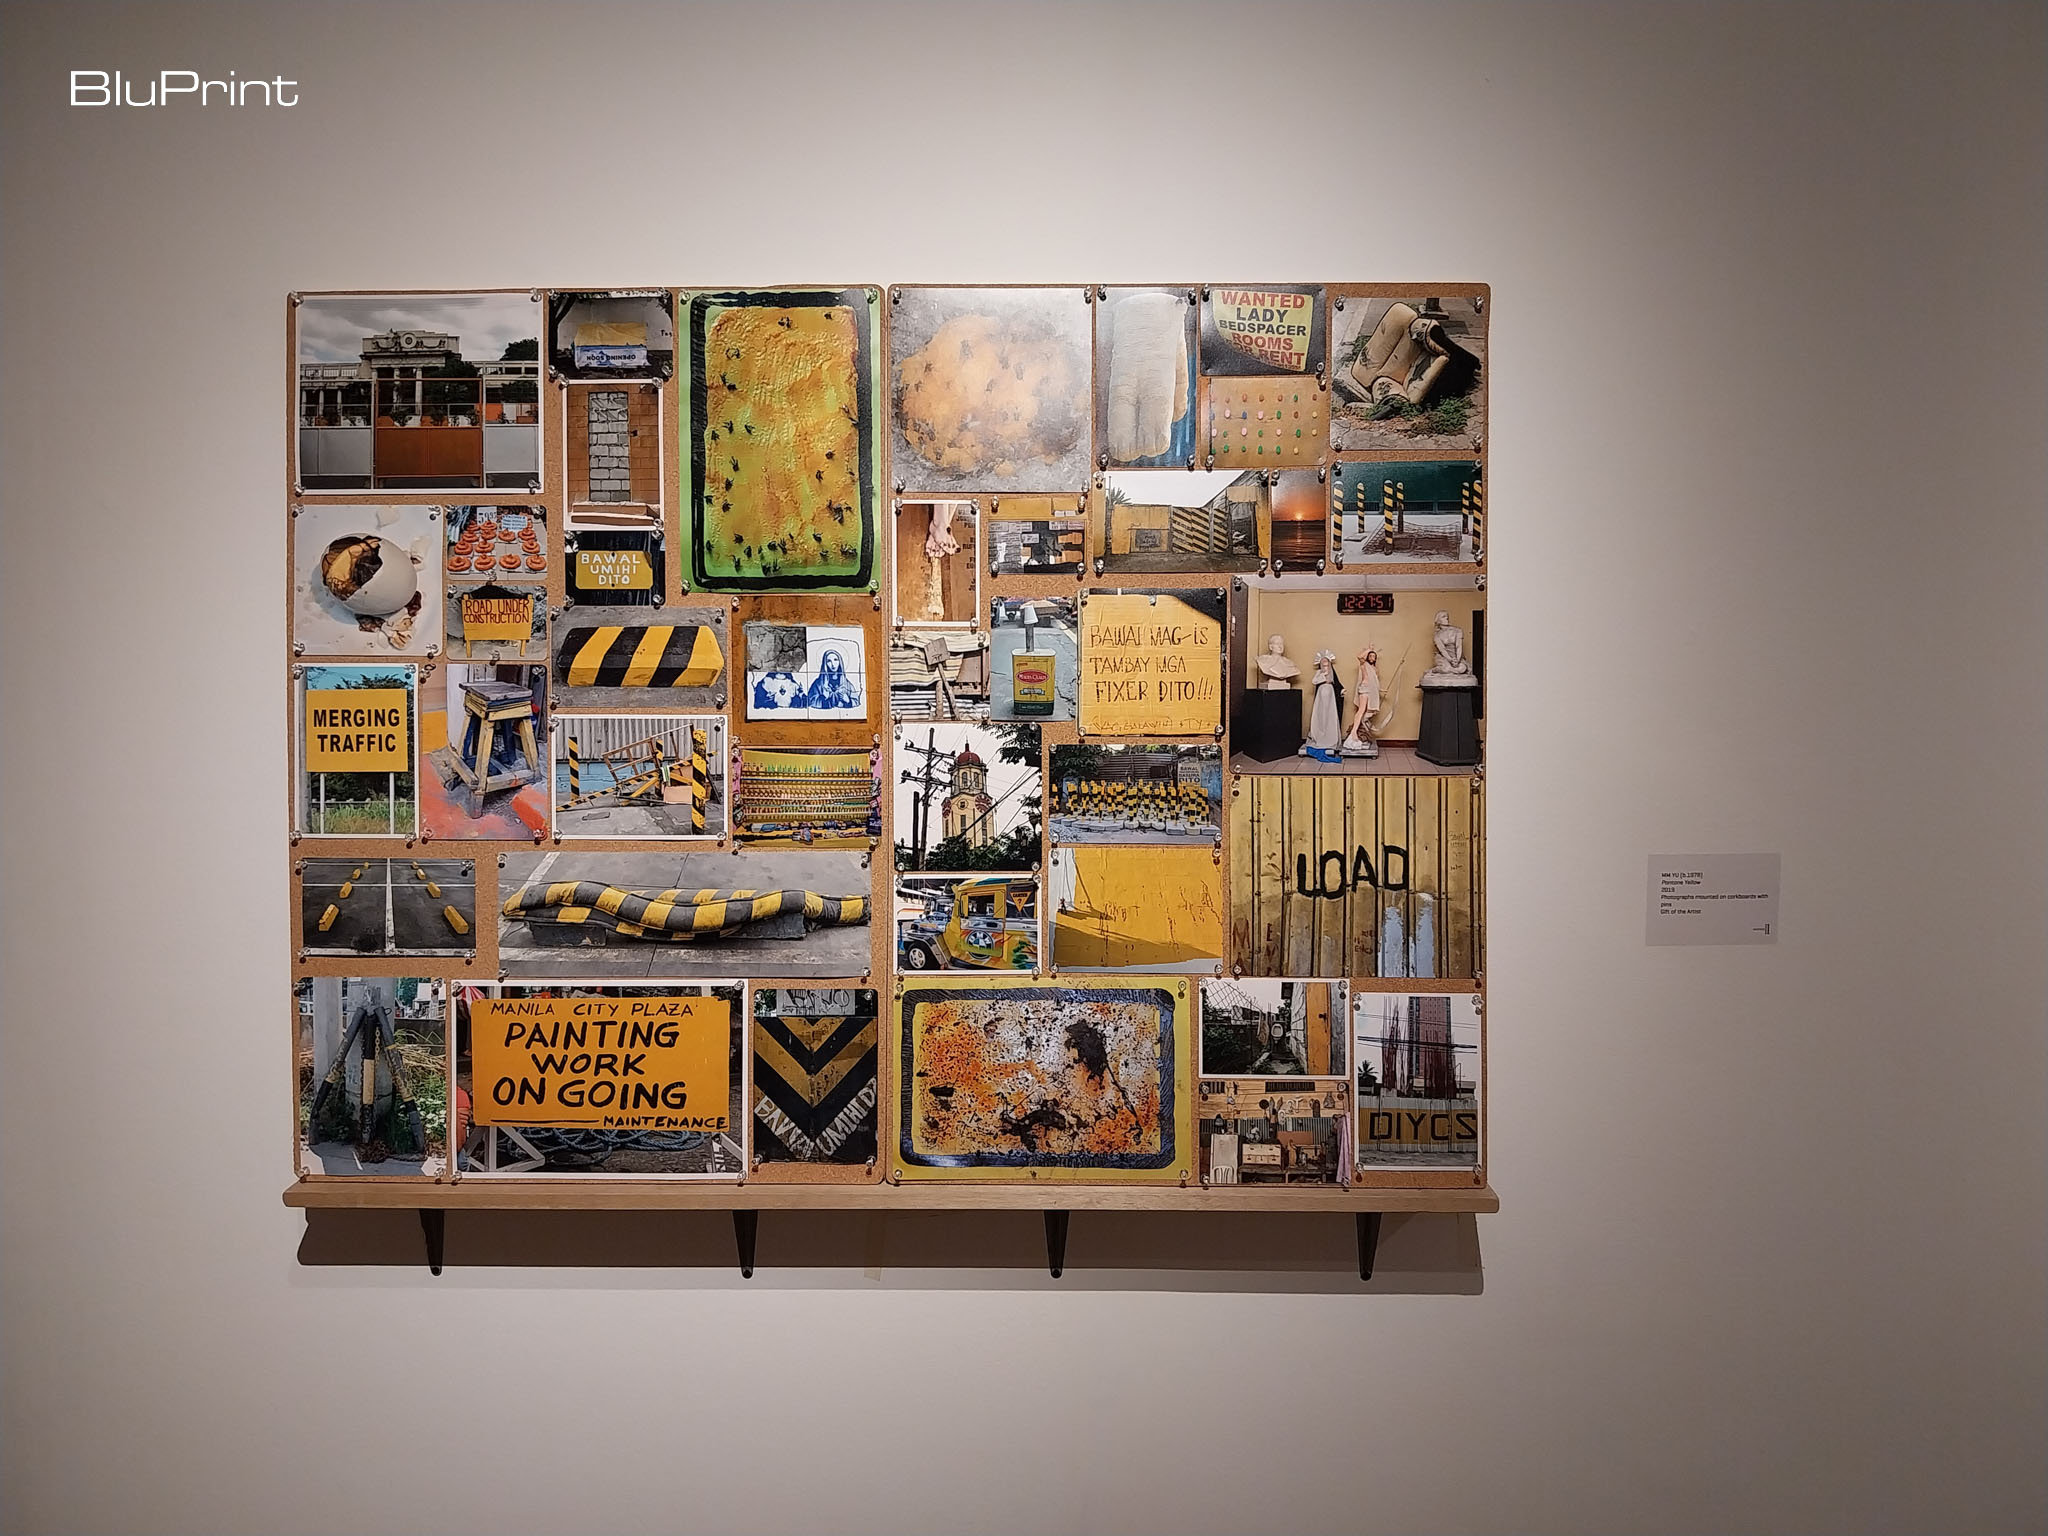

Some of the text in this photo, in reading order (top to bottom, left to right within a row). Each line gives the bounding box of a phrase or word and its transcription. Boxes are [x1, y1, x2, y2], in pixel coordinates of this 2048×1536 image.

[1221, 291, 1305, 309] WANTED
[1236, 307, 1288, 323] LADY
[1219, 319, 1306, 336] BEDSPACER
[1231, 332, 1294, 351] ROOMS
[1258, 348, 1305, 366] RENT
[581, 553, 641, 564] BAWAL
[590, 564, 637, 575] UMIHI
[598, 574, 630, 585] DITO
[465, 599, 530, 615] ROAD UNDER
[1344, 595, 1392, 609] 12:27:51
[463, 613, 530, 624] CONSTRUCTION
[1089, 656, 1187, 675] TAMBAY MGA
[1096, 677, 1213, 703] FIXER DITO!!!
[313, 708, 400, 728] MERGING
[317, 733, 397, 753] TRAFFIC
[1297, 843, 1409, 900] LOAD
[490, 1002, 694, 1017] MANILA CITY PLAZA
[504, 1021, 680, 1050] PAINTING
[531, 1053, 646, 1077] WORK
[492, 1077, 687, 1110] ON GOING
[604, 1115, 729, 1129] MAINTENANCE
